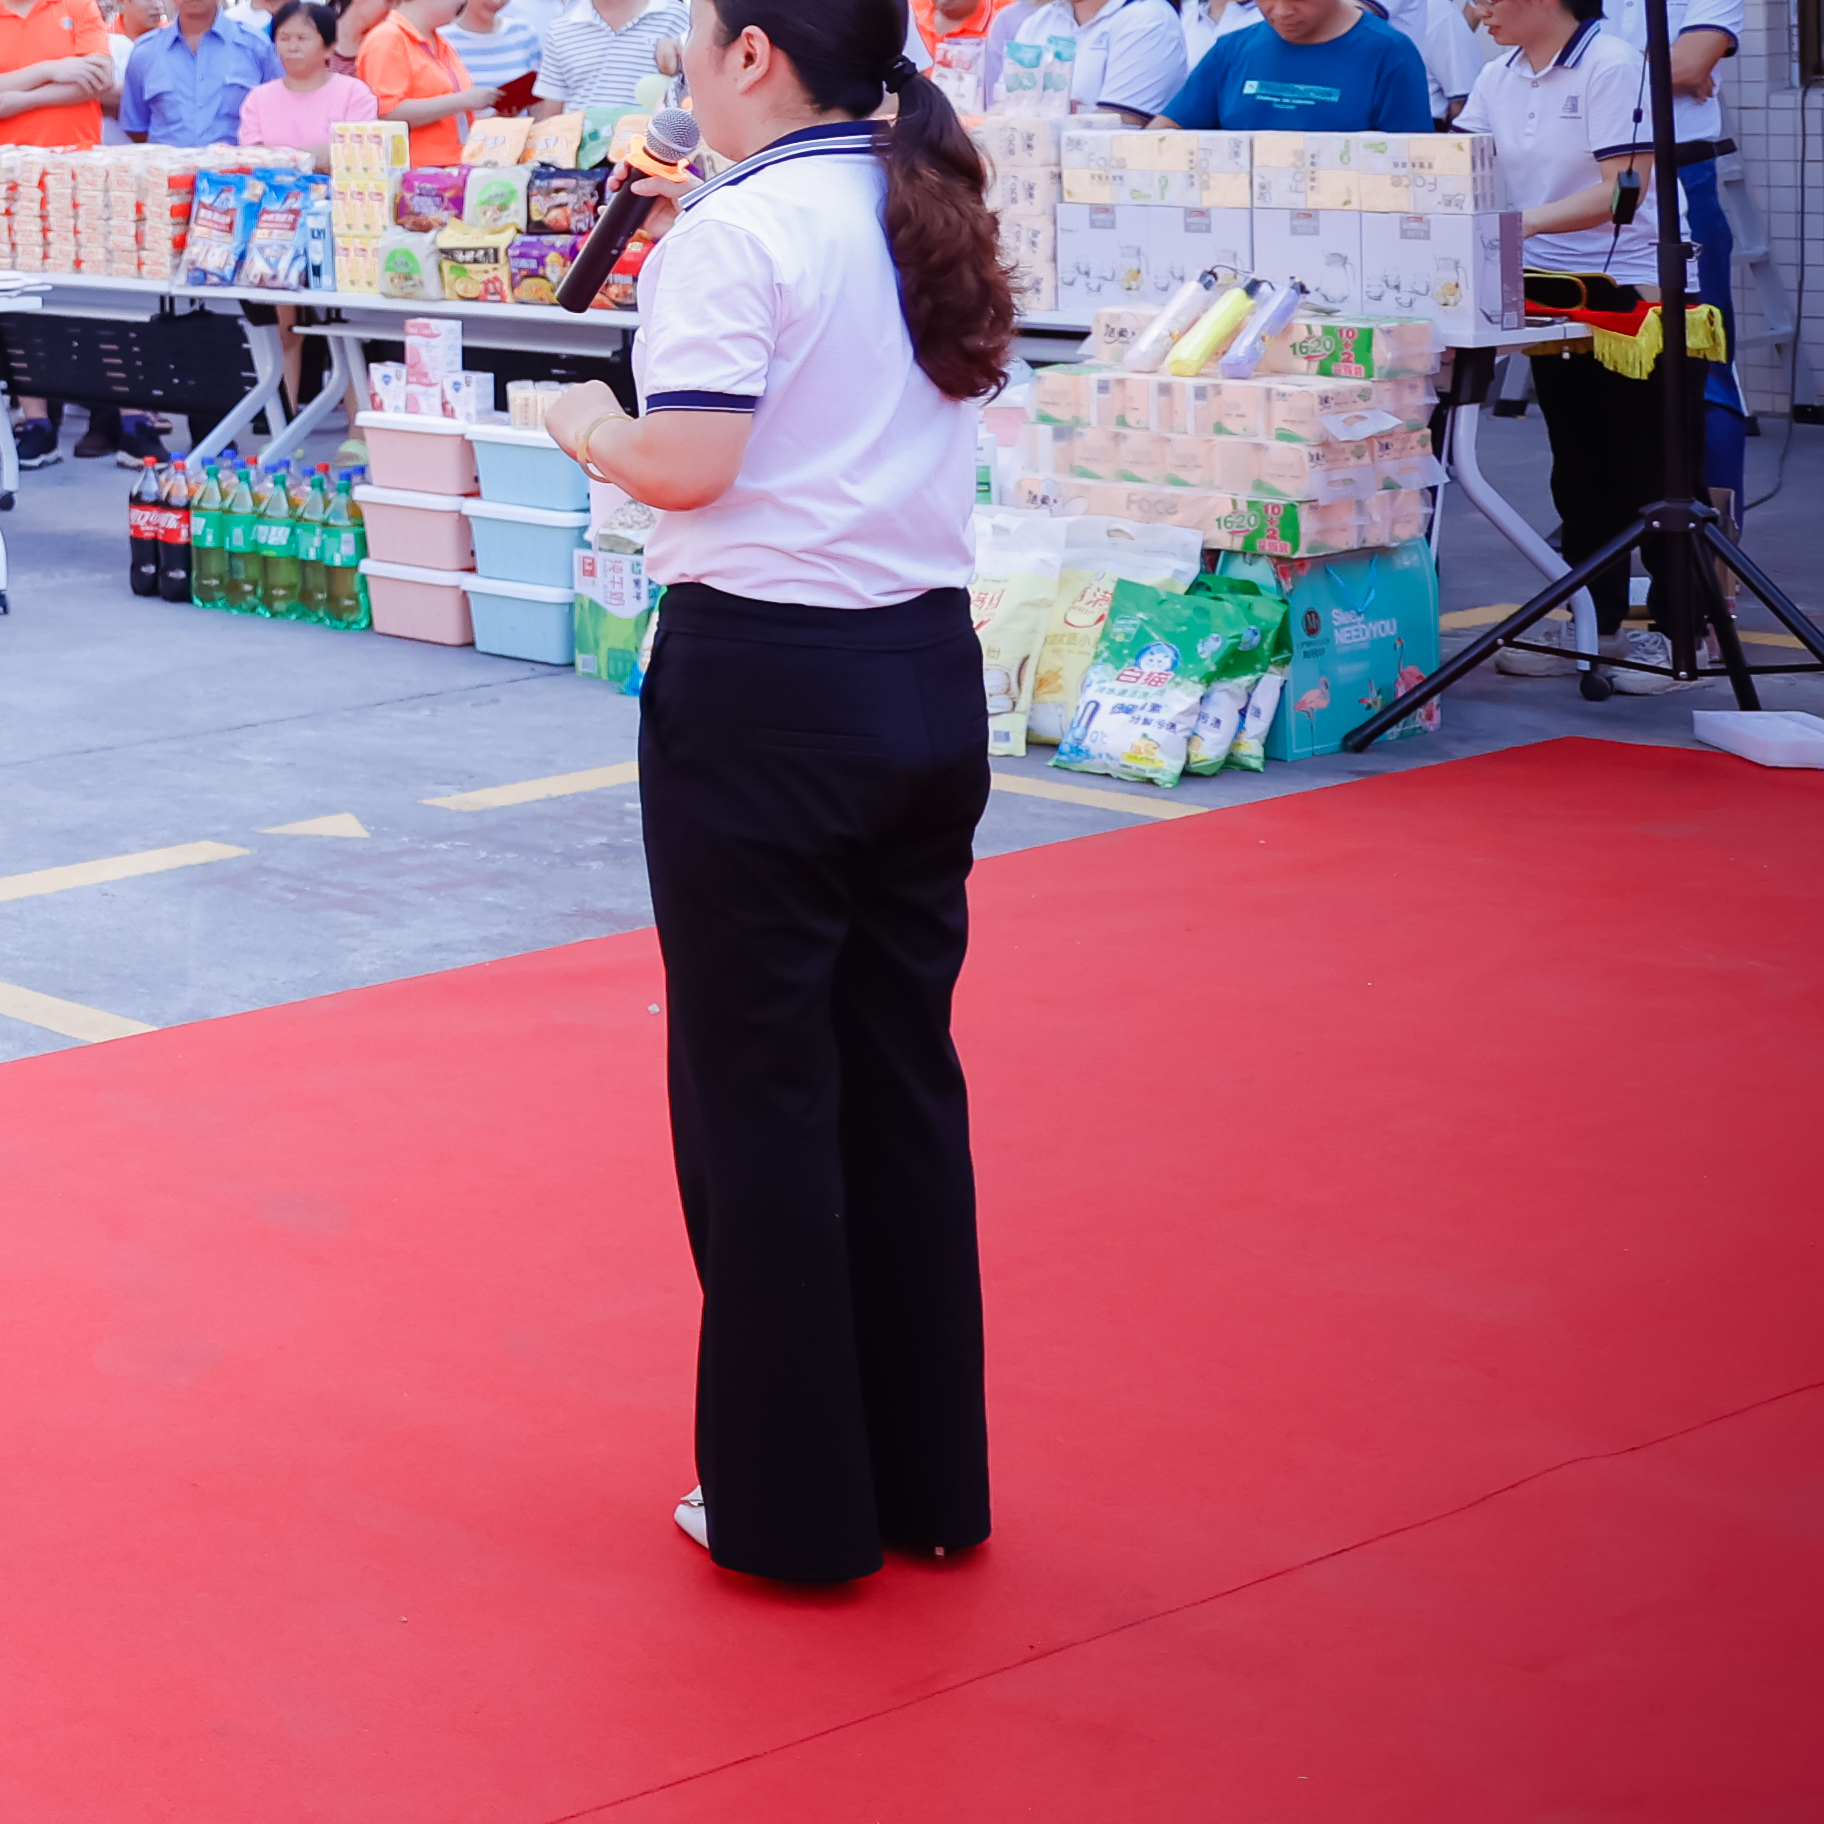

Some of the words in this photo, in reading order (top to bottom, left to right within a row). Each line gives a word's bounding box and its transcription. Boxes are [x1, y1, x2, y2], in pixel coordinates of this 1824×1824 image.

[1337, 327, 1357, 340] 10
[1289, 336, 1334, 355] 1620
[1341, 351, 1354, 363] 2
[1263, 503, 1283, 516] 10
[1216, 513, 1258, 530] 1620
[1266, 527, 1278, 540] 2
[609, 559, 625, 607] 纯牛奶
